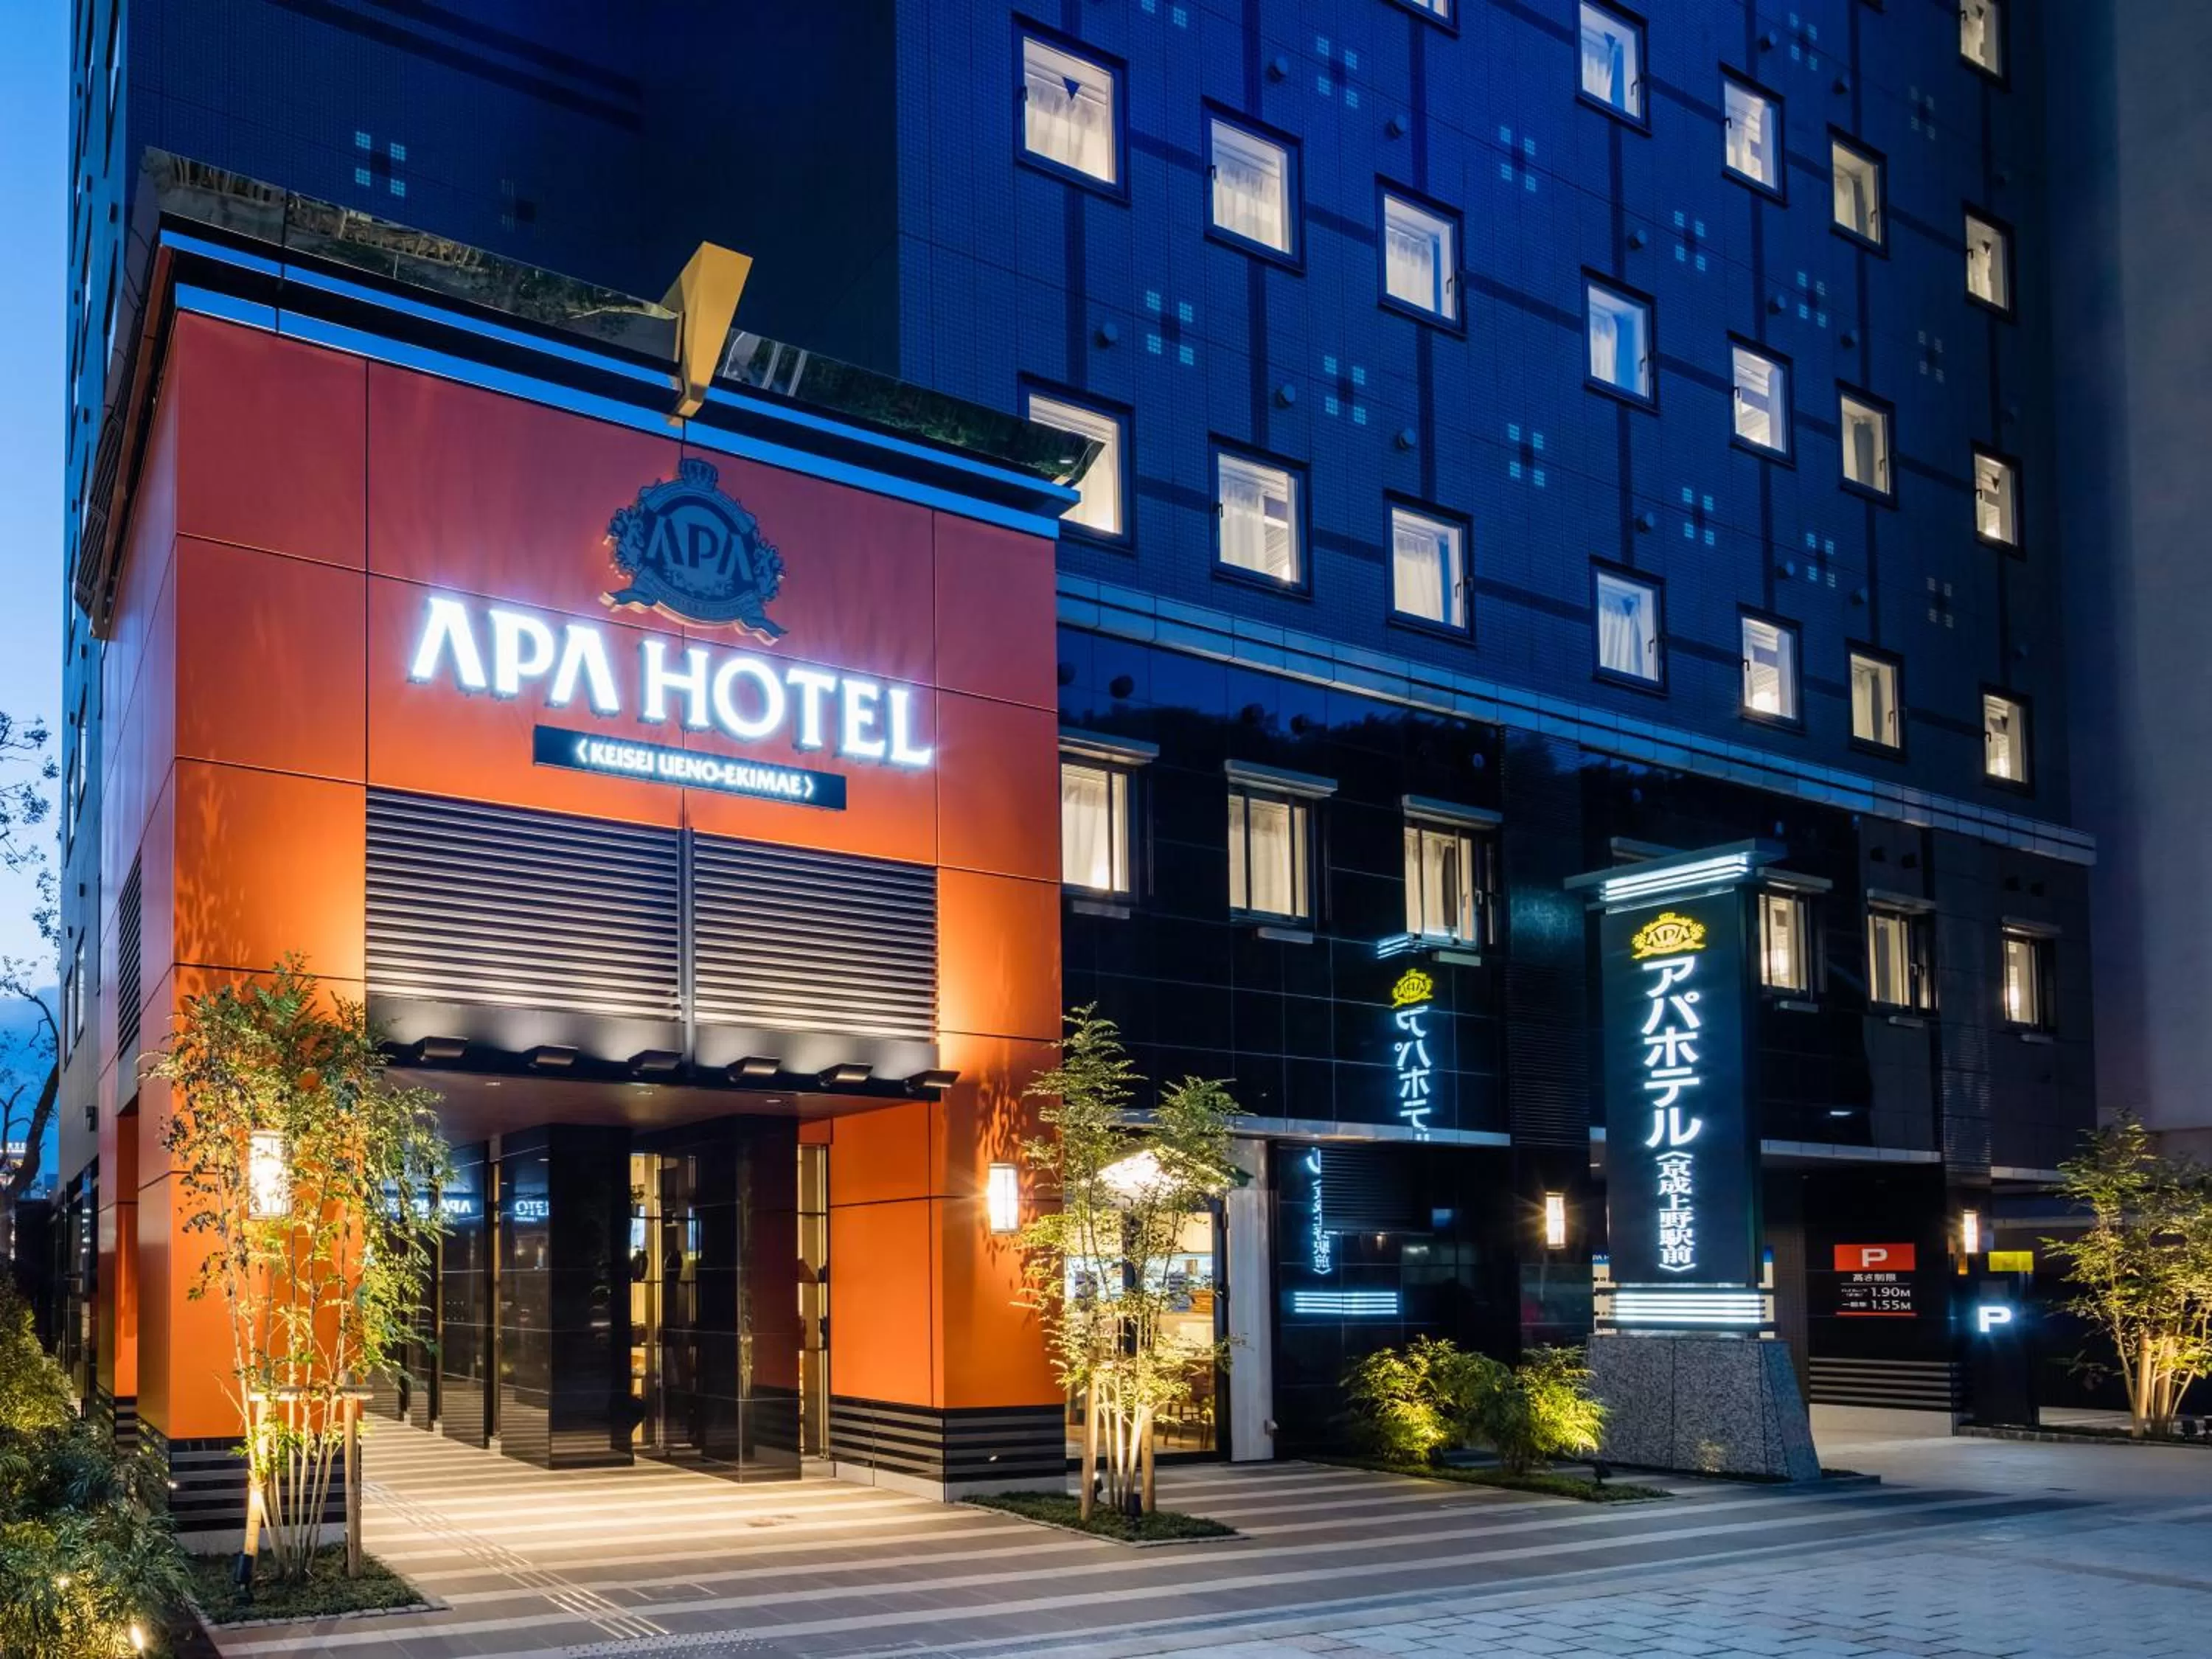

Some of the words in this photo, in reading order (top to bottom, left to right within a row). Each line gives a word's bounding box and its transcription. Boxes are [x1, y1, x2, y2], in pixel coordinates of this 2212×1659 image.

[644, 515, 757, 581] APA
[408, 597, 621, 717] APA
[639, 639, 933, 766] HOTEL
[1642, 956, 1702, 1149] アパホテル
[1862, 1248, 1888, 1267] P
[1978, 1306, 2011, 1332] P
